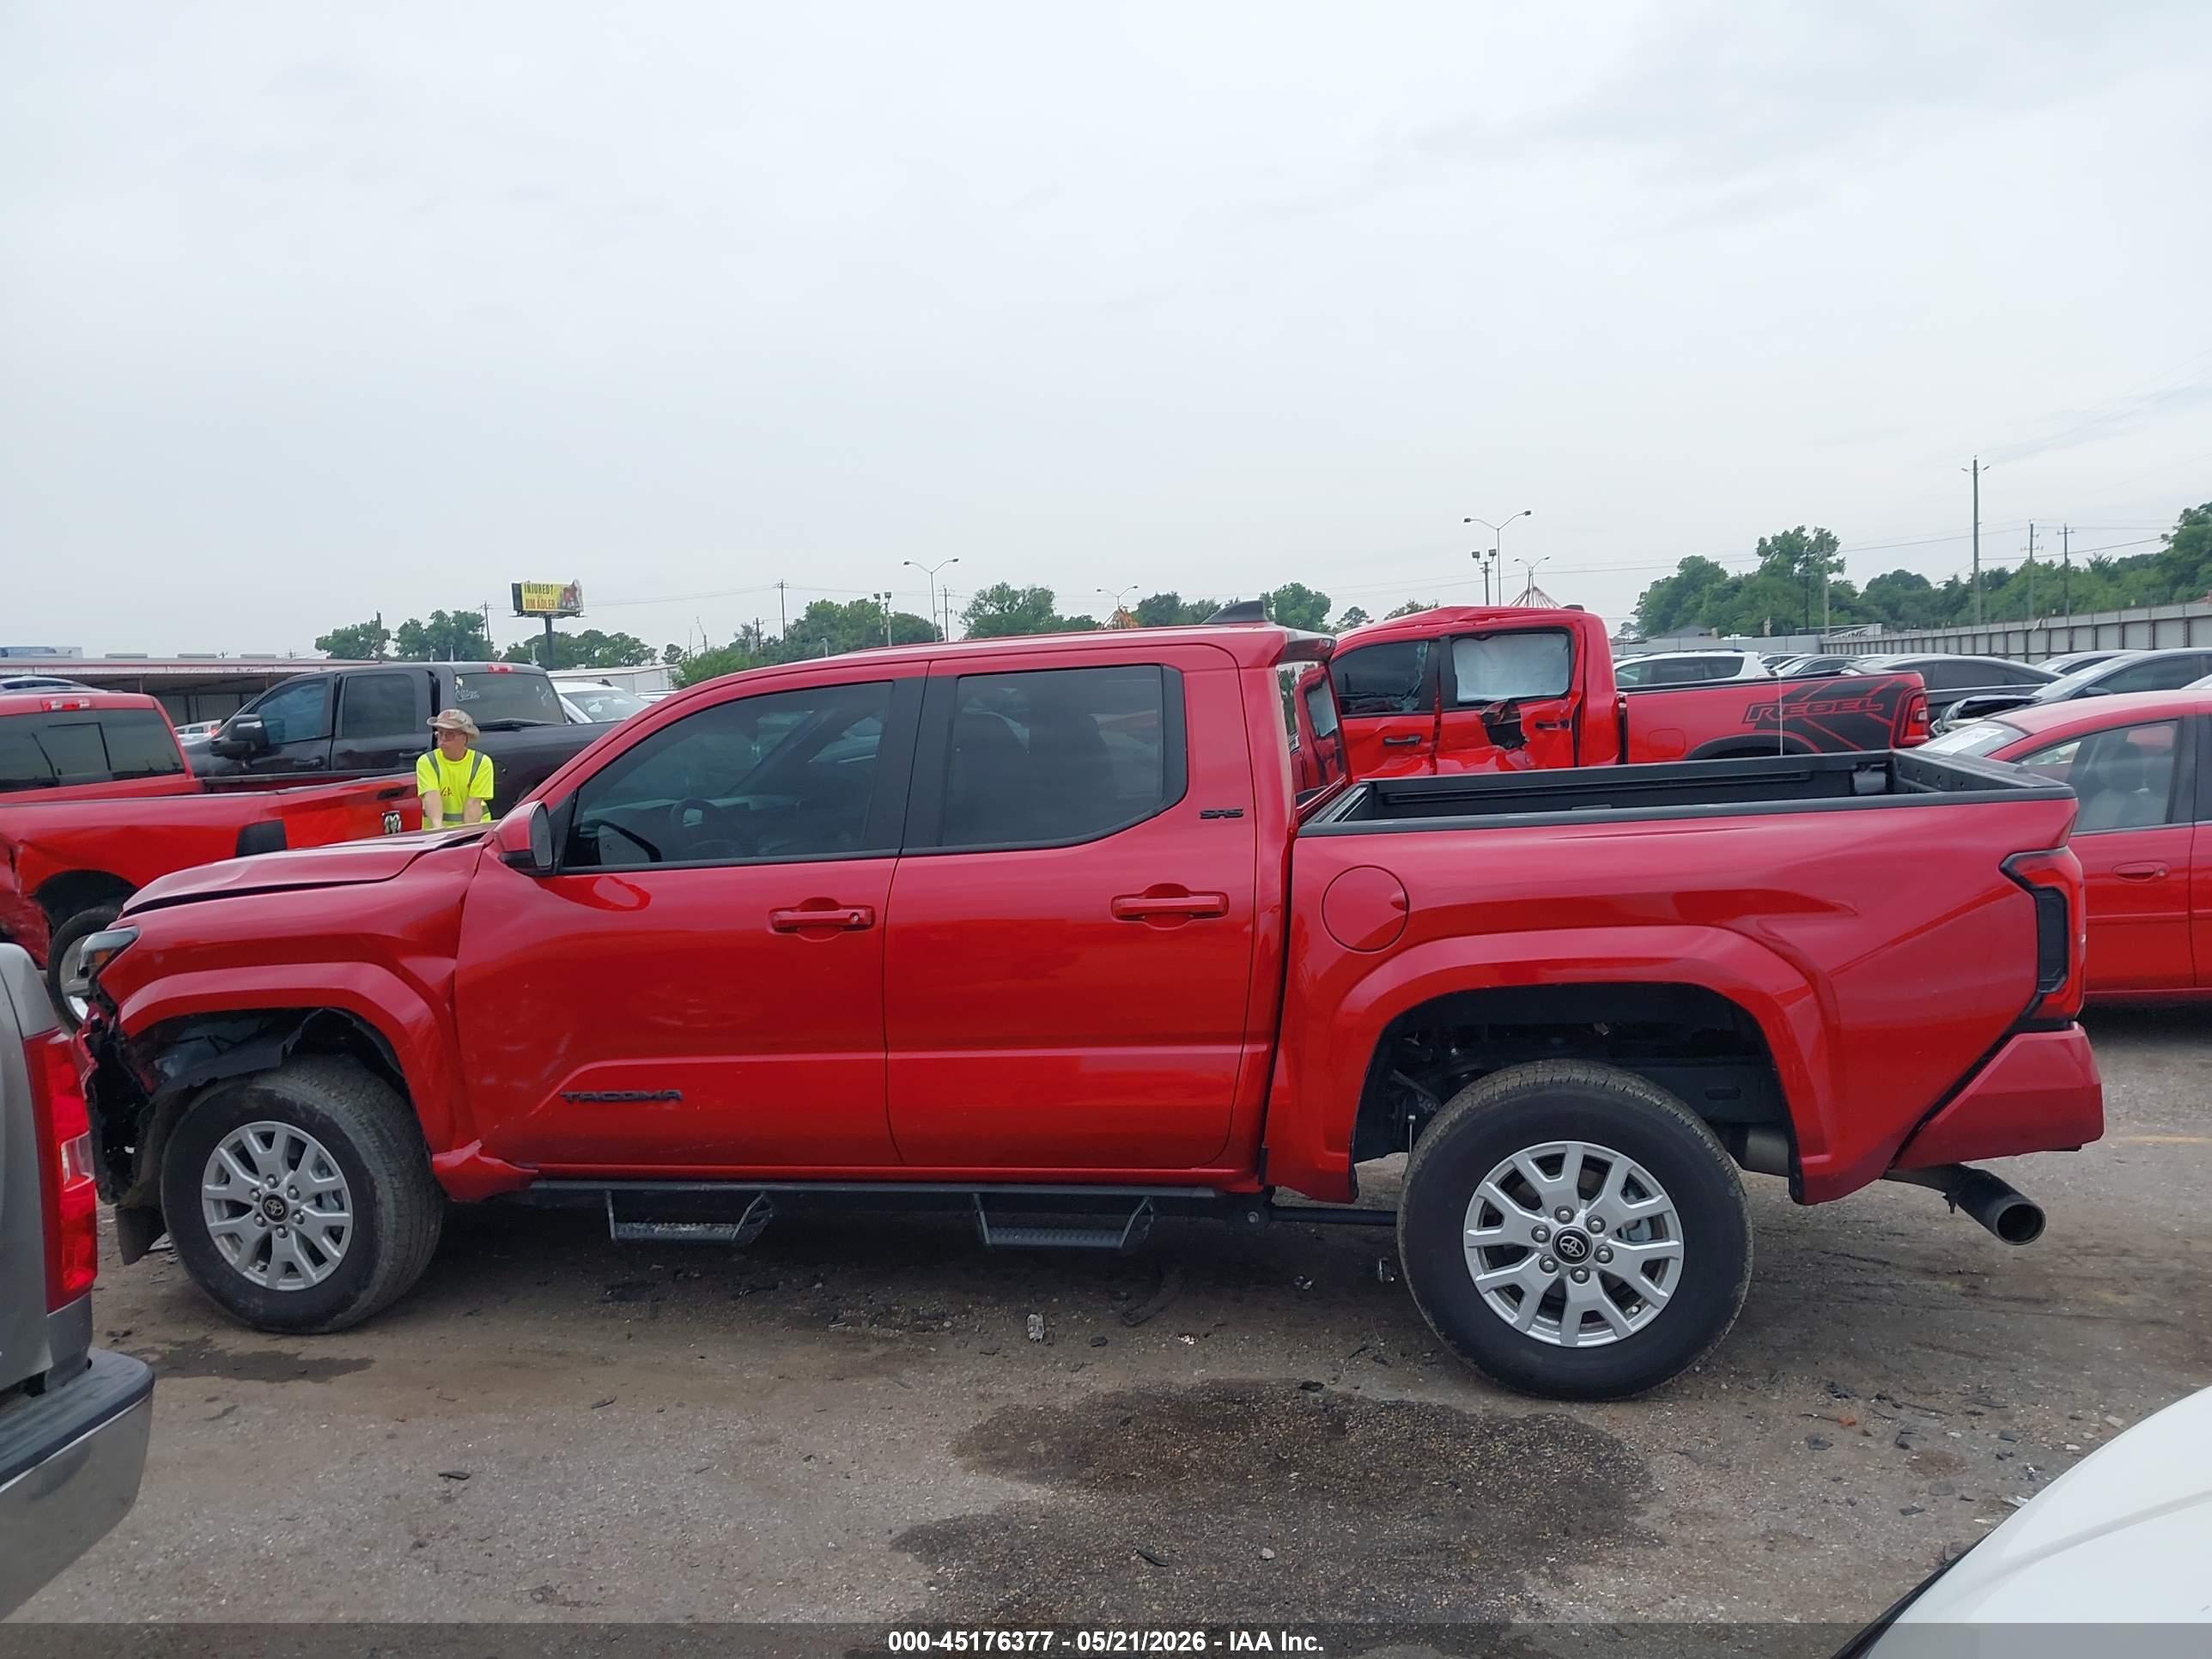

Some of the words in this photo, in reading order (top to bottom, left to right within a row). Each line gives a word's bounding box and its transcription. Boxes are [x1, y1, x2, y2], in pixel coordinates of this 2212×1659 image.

[524, 584, 554, 594] INJURED?
[525, 599, 536, 610] JIM
[537, 599, 556, 610] ADLER
[1742, 696, 1884, 724] REBEL
[560, 1089, 684, 1103] TACOMA
